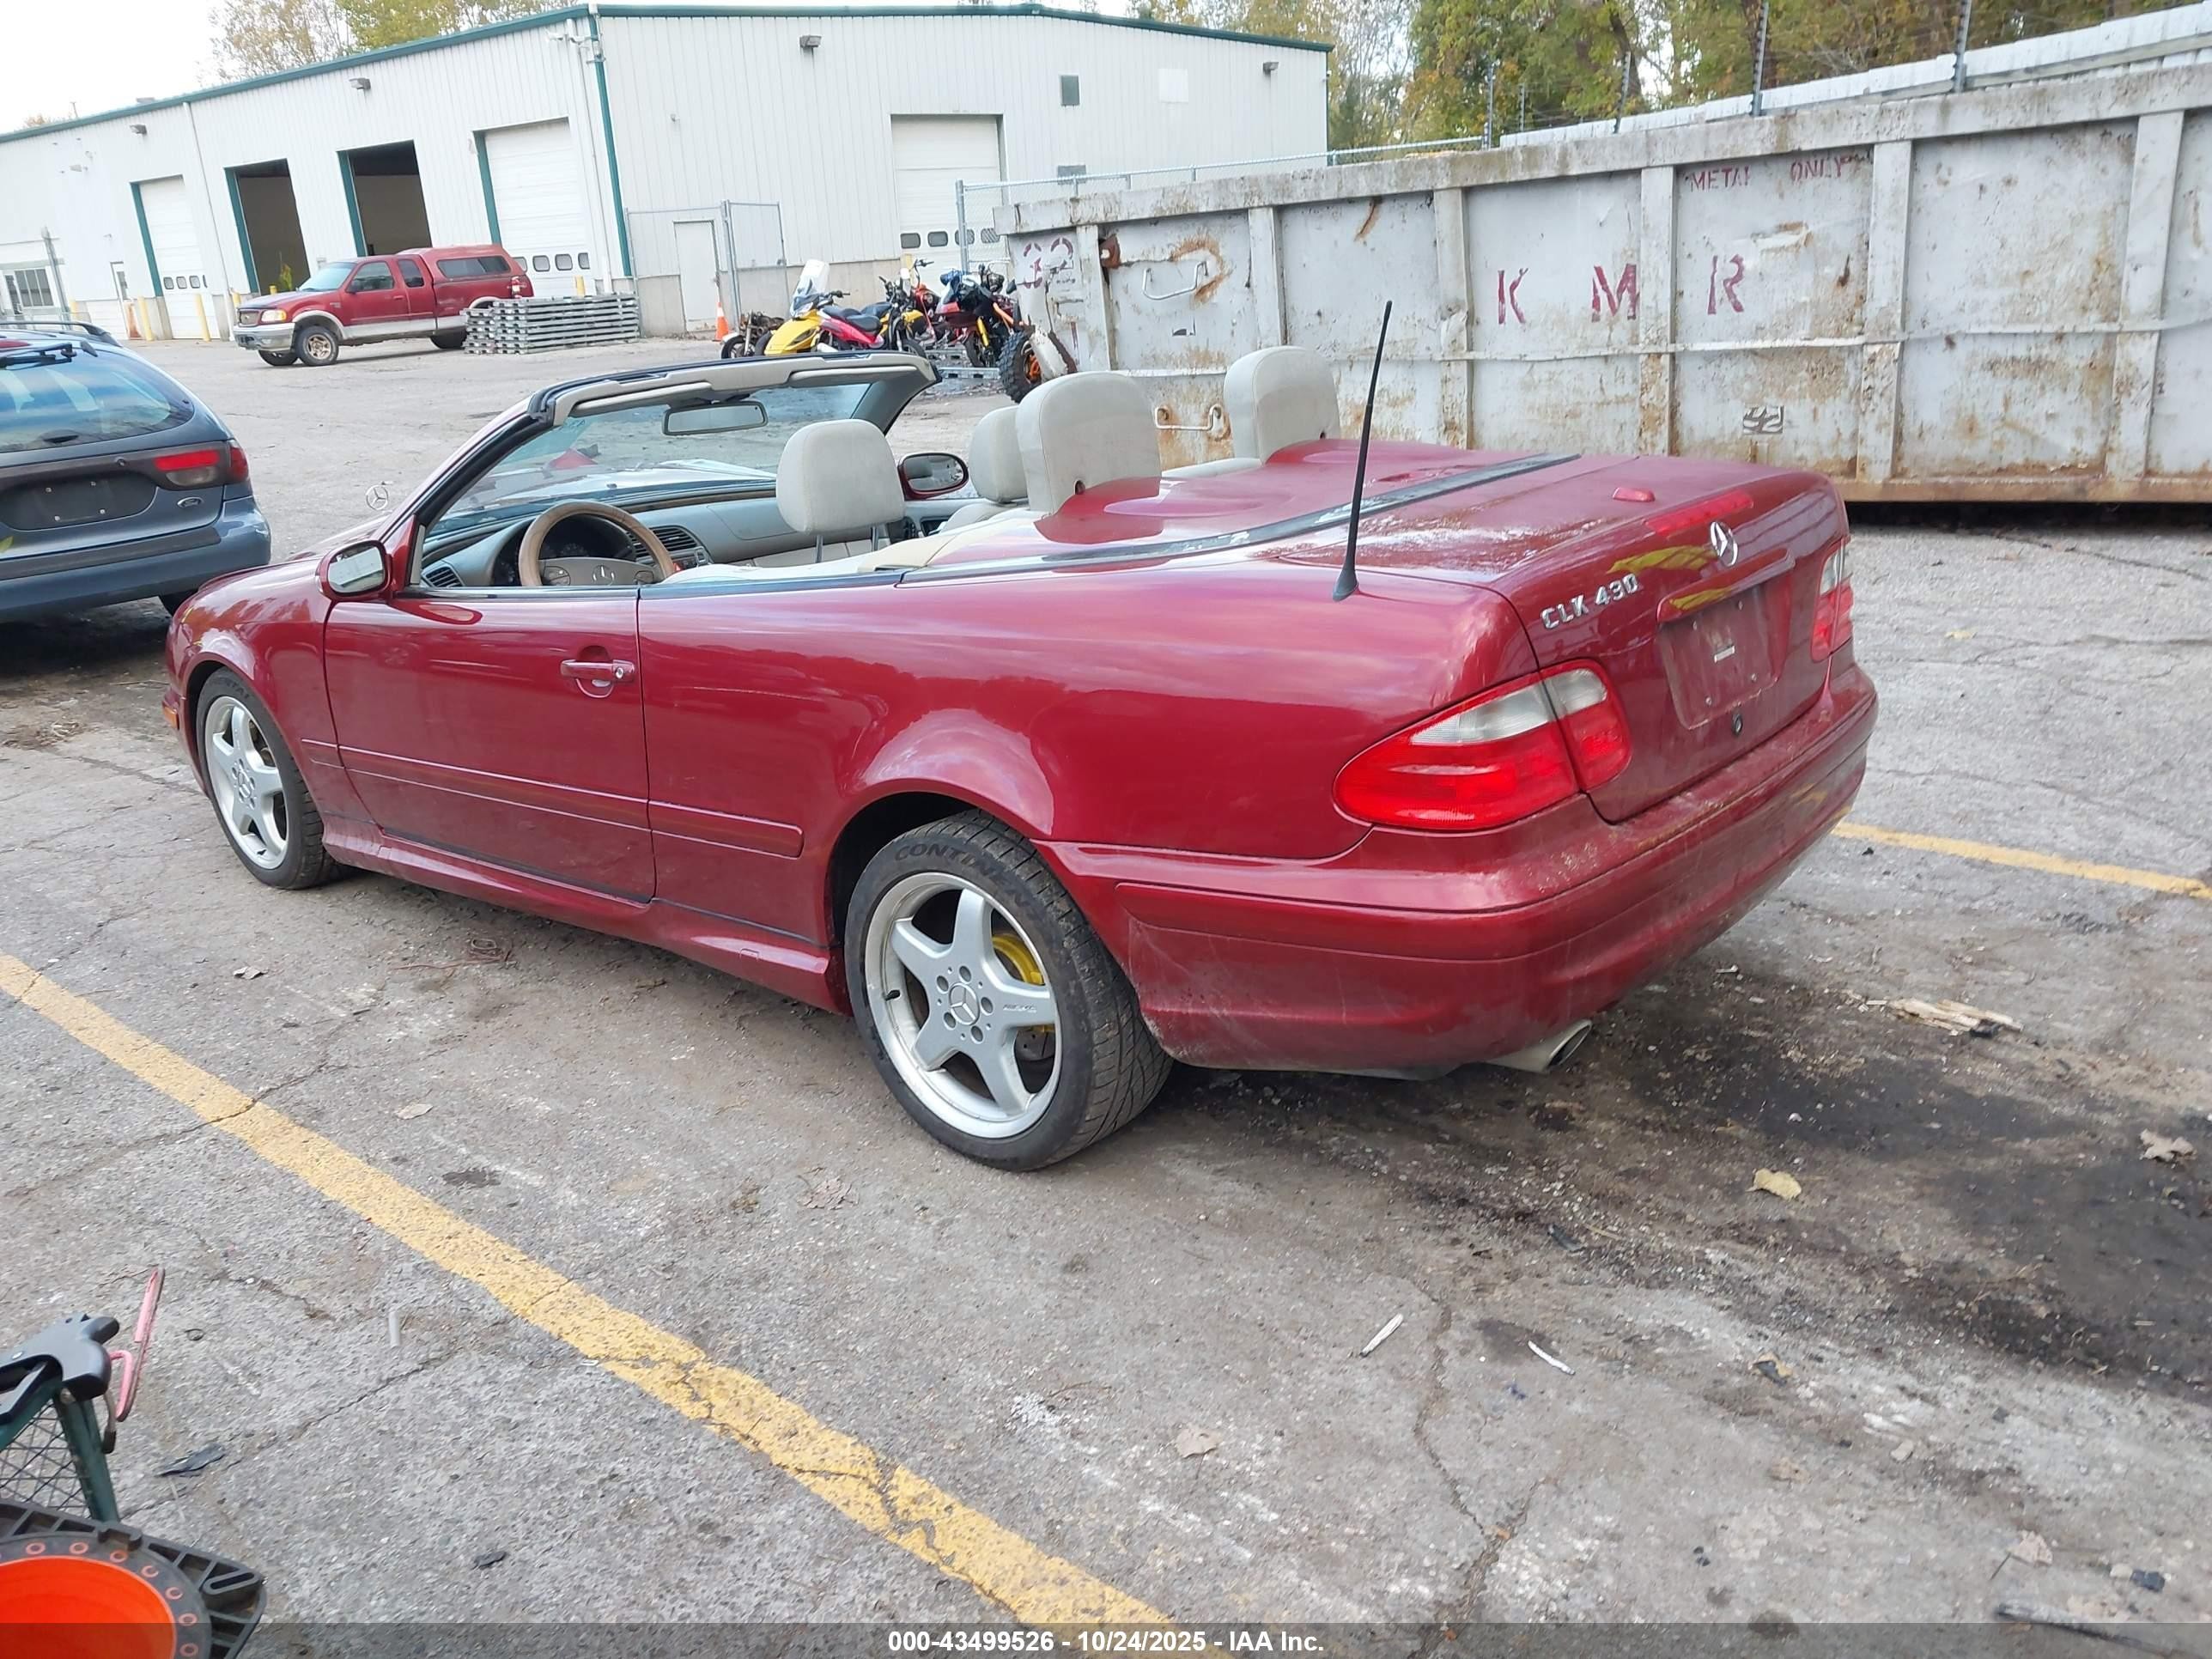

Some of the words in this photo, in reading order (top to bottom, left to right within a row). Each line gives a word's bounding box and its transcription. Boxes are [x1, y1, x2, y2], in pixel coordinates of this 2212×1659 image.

[1790, 155, 1844, 183] ONLY
[1498, 268, 1528, 325] K
[1591, 263, 1637, 323] M
[1707, 253, 1744, 315] R
[1540, 594, 1589, 629] CLK
[1595, 573, 1639, 605] 430
